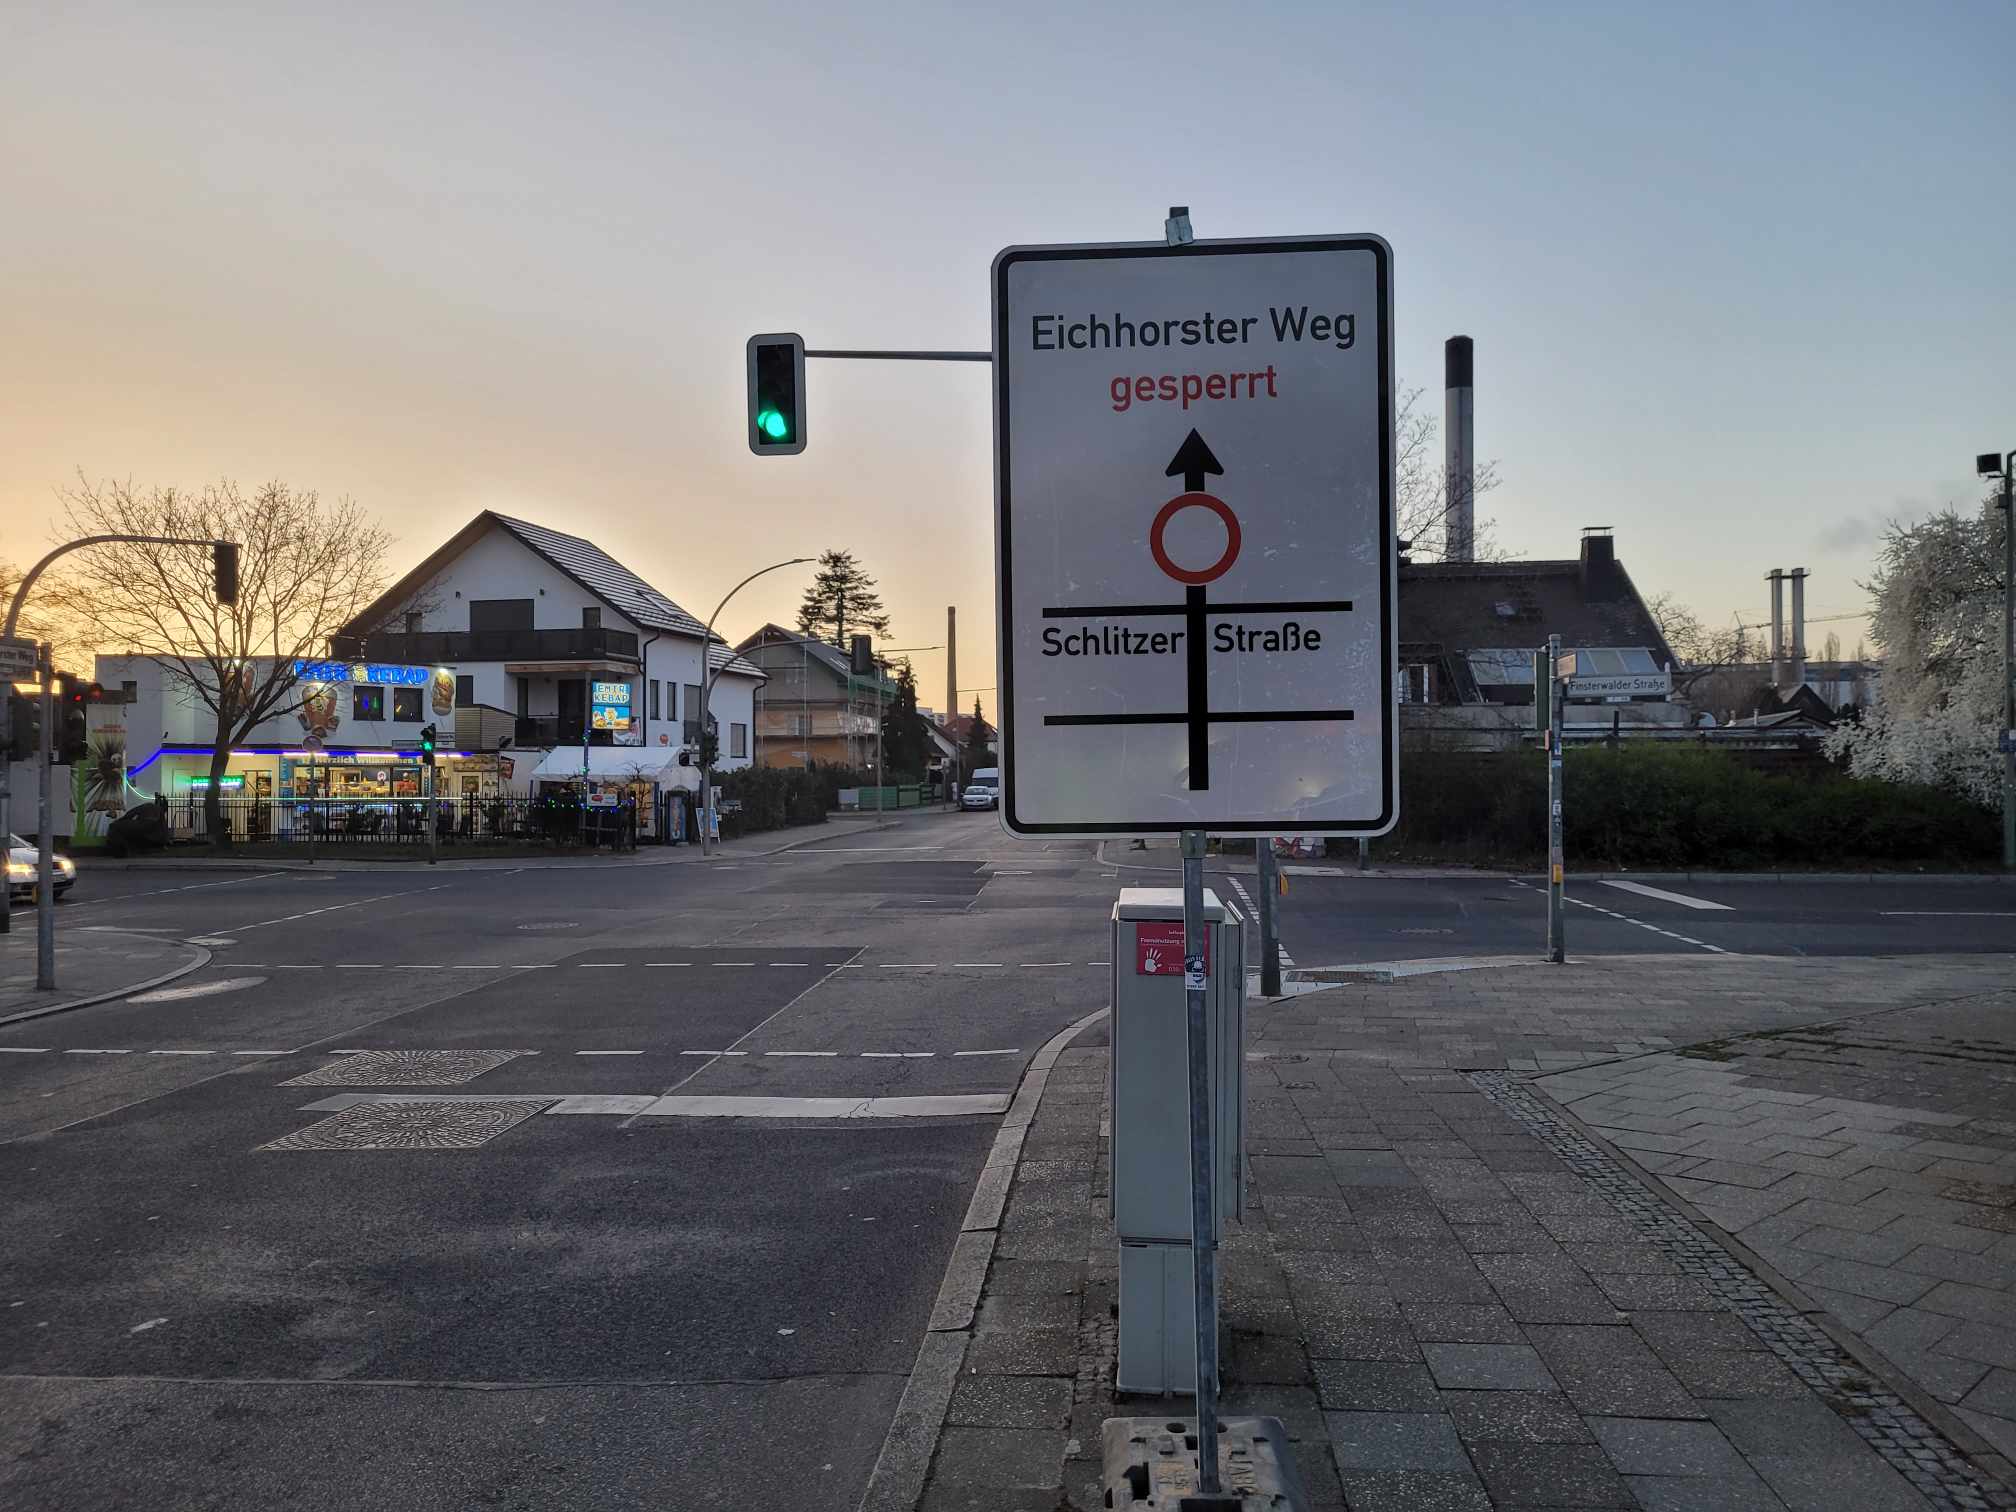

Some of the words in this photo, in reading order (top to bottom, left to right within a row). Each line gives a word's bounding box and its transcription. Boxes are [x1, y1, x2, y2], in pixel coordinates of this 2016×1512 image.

[1032, 312, 1258, 351] Eichhorster
[1269, 306, 1356, 350] Weg
[1110, 365, 1278, 413] gesperrt
[1041, 626, 1185, 656] Schlitzer
[1213, 621, 1321, 653] Straße
[598, 684, 625, 693] EMIR
[1569, 679, 1632, 691] Finsterwalder
[1633, 679, 1665, 691] Straße
[594, 694, 628, 703] KEBAP
